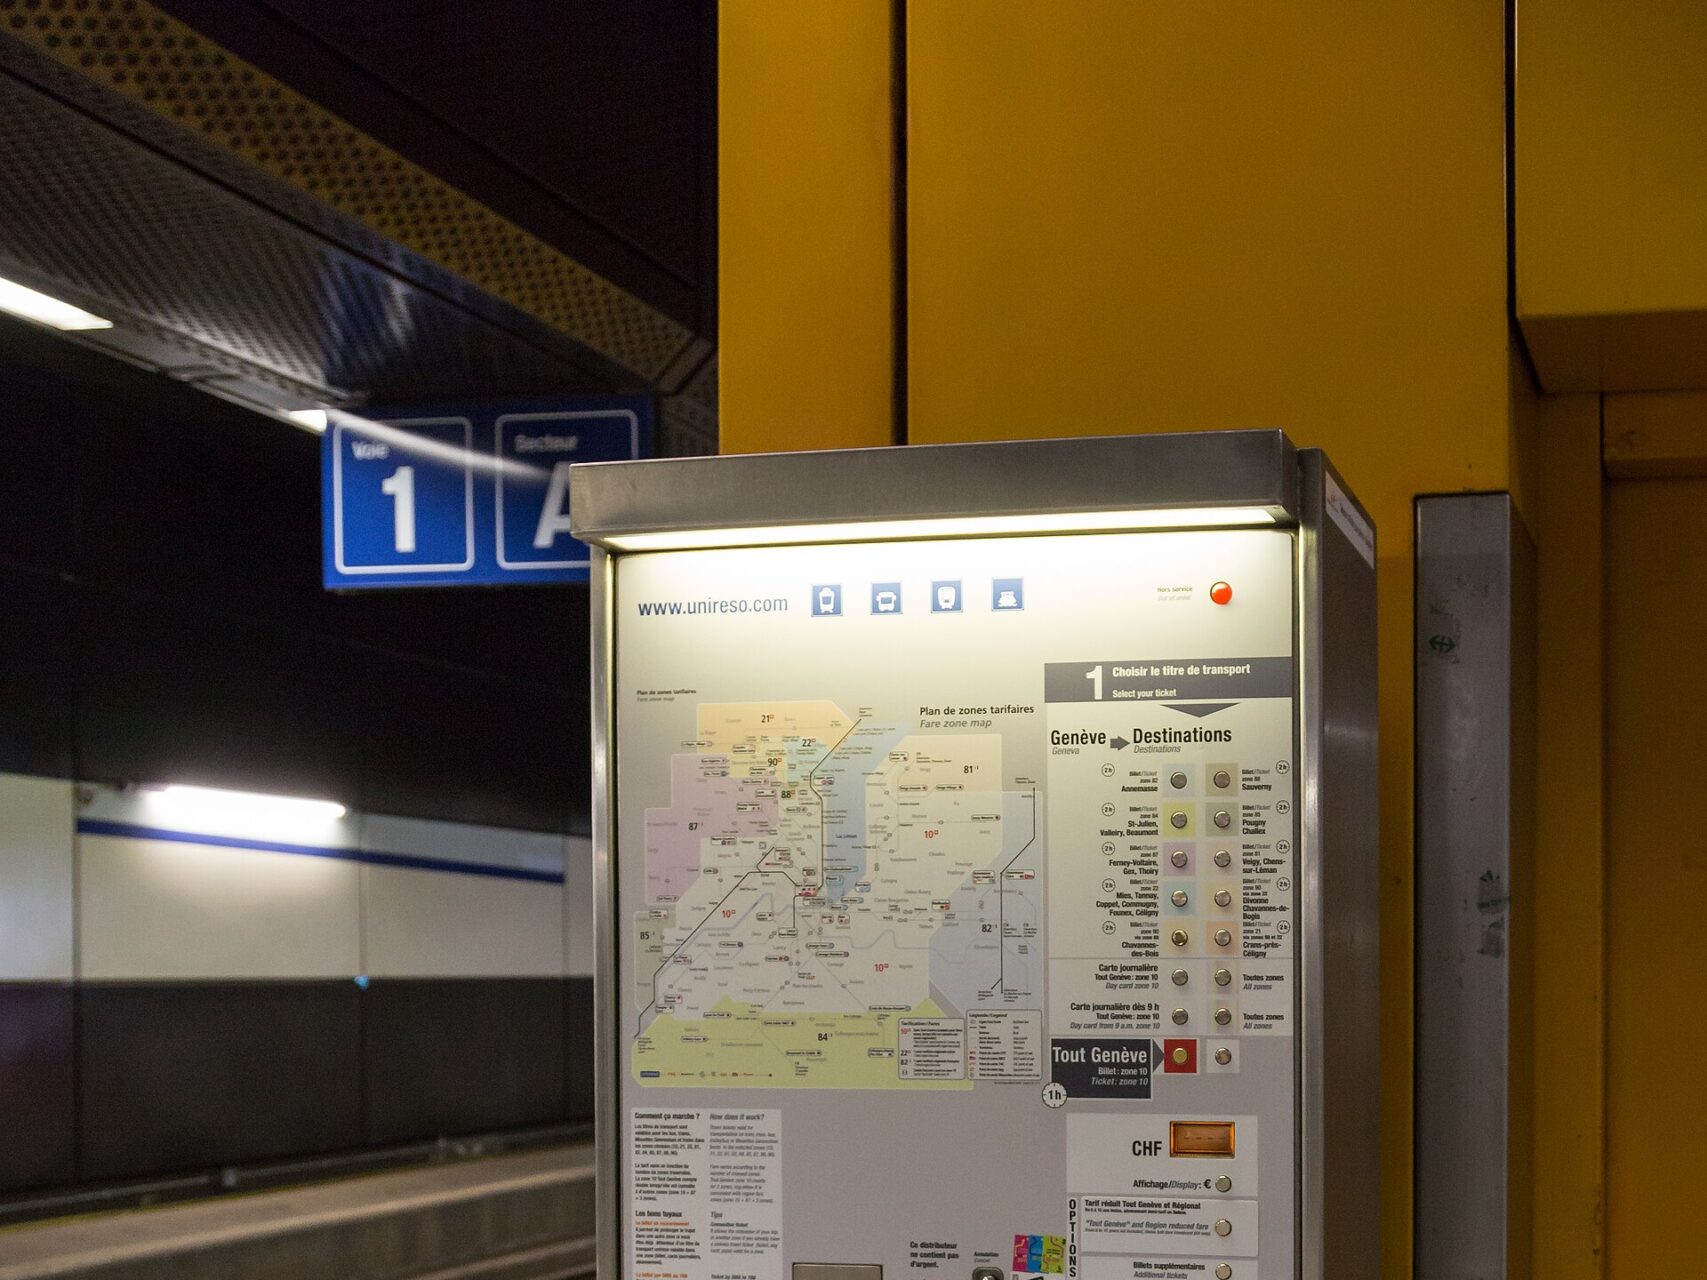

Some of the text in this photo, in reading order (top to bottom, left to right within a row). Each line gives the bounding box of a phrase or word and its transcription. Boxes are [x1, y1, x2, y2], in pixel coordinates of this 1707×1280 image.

[514, 435, 578, 452] Secteur
[352, 442, 390, 459] Voie
[382, 466, 415, 552] 1
[638, 597, 788, 616] www.unireso.com
[1113, 664, 1250, 677] Choisir le titre de transport
[1086, 666, 1102, 700] 1
[1113, 689, 1176, 699] Select your ticket
[920, 707, 940, 715] Plan
[944, 706, 956, 715] de
[991, 705, 1034, 714] tarifaires
[761, 715, 770, 723] 21
[920, 720, 940, 728] Fare
[970, 720, 991, 729] map
[1051, 729, 1106, 745] Genève
[1133, 728, 1232, 743] Destinations
[802, 739, 811, 747] 22
[1052, 747, 1079, 755] Geneva
[1134, 745, 1181, 753] Destinations
[768, 758, 777, 766] 90
[722, 910, 731, 918] 10
[982, 924, 992, 932] 82
[640, 932, 649, 940] 85
[874, 964, 884, 972] 10
[1120, 964, 1158, 973] journalière
[1071, 1003, 1159, 1012] Carte journalière dès 9 h
[818, 1033, 827, 1041] 84
[1053, 1047, 1147, 1063] Tout Genève
[1141, 1067, 1147, 1075] 10
[1132, 1141, 1162, 1156] CHF
[1204, 1179, 1211, 1189] €
[1101, 1200, 1120, 1208] réduit
[1172, 1202, 1200, 1210] Régional
[920, 1241, 957, 1249] distributeur
[920, 1251, 945, 1259] contient
[1154, 1263, 1205, 1271] supplémentaires
